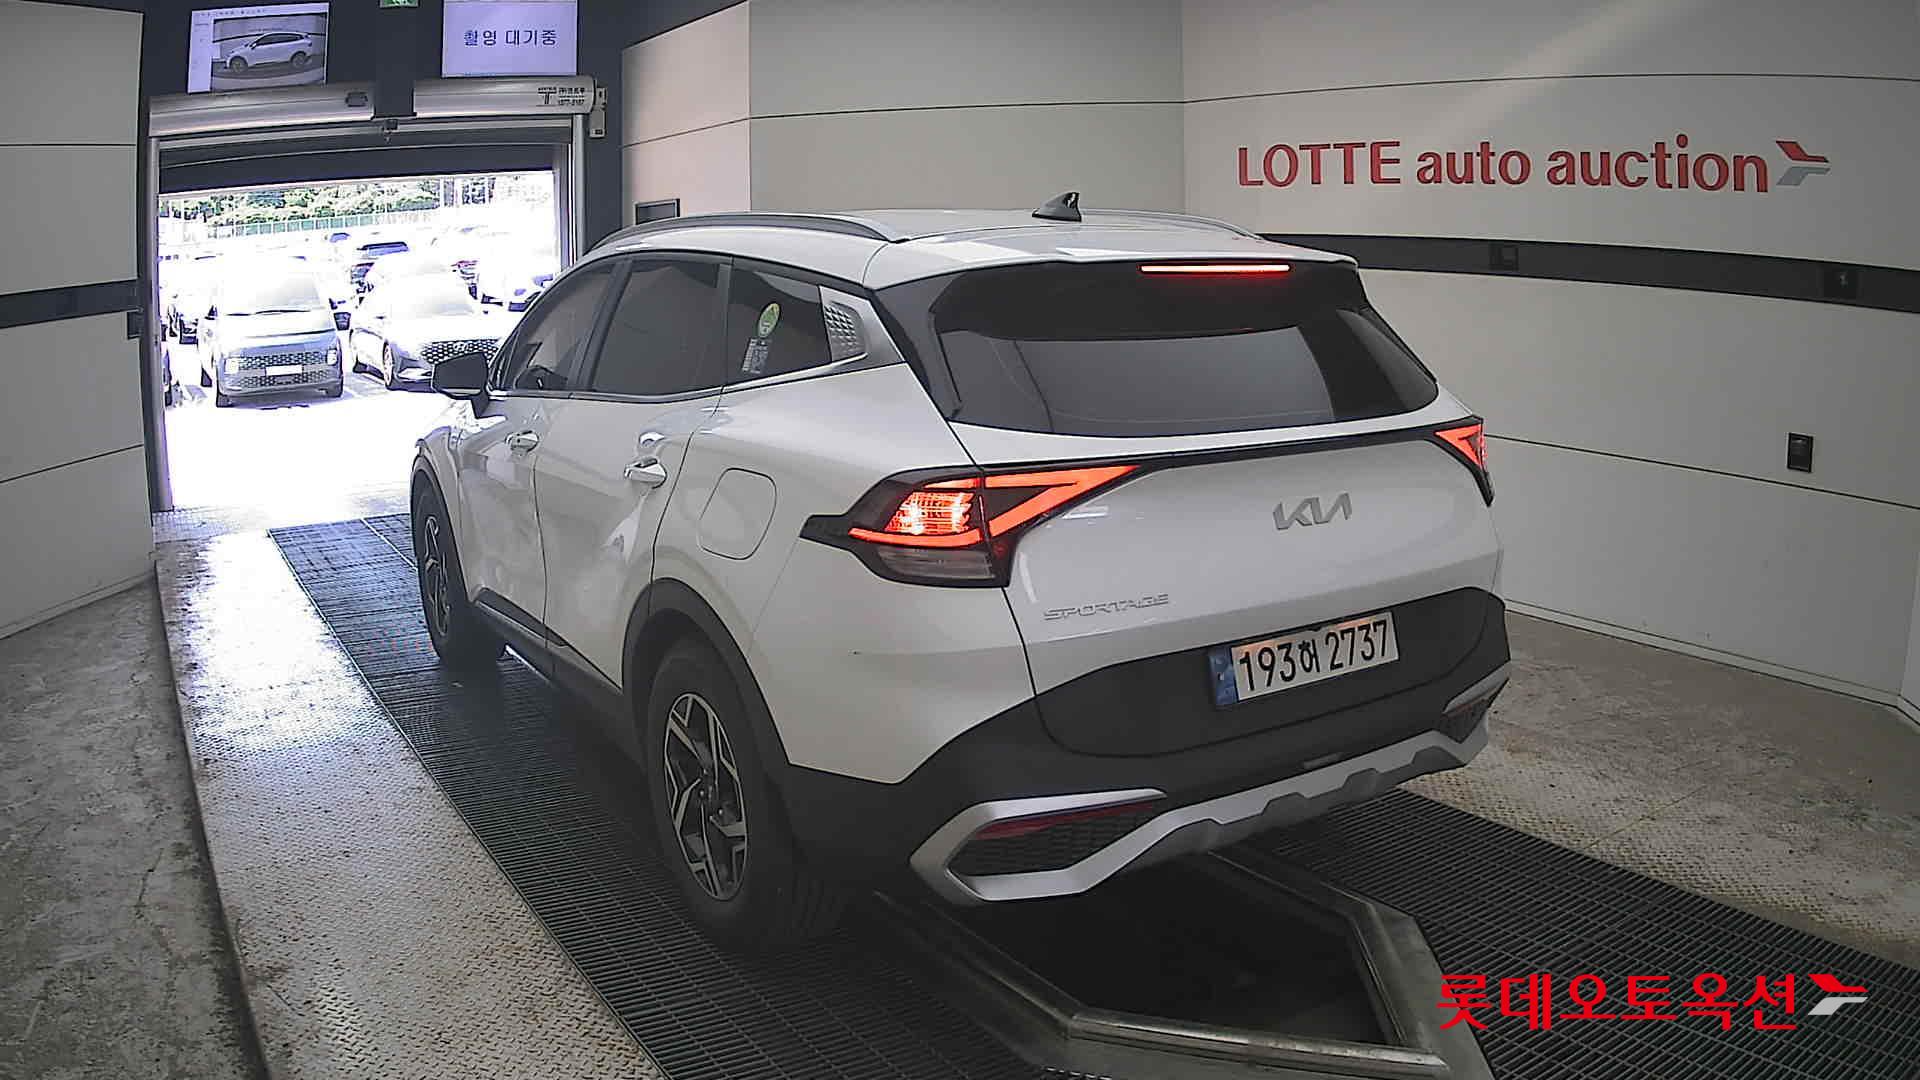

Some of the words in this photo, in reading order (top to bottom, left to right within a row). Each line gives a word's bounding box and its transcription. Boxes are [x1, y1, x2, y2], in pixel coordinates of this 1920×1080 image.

[505, 29, 557, 46] 대기중
[1238, 140, 1400, 188] LOTTE
[1416, 141, 1531, 186] auto
[1546, 134, 1769, 193] auction
[1272, 492, 1353, 531] KIA
[1044, 593, 1169, 621] SPORTAGE
